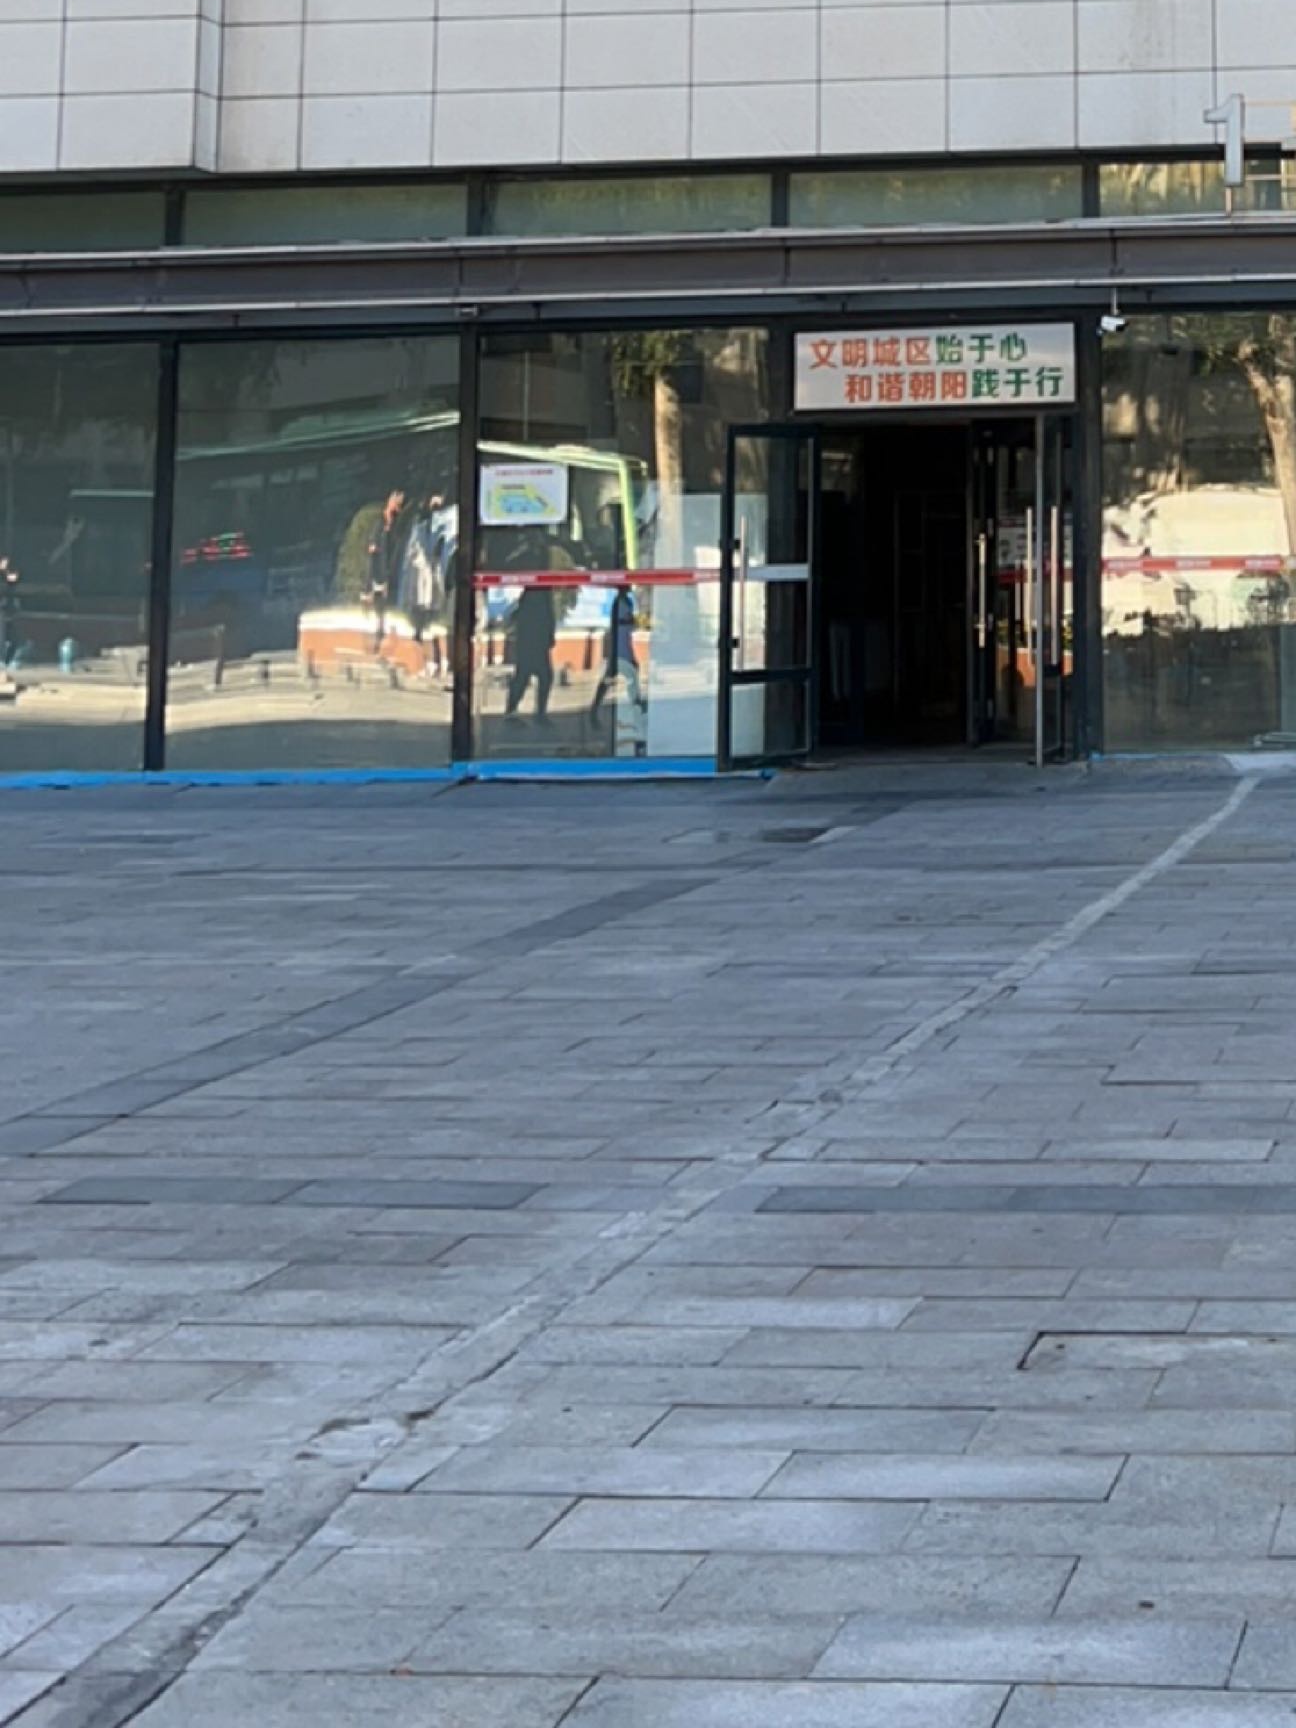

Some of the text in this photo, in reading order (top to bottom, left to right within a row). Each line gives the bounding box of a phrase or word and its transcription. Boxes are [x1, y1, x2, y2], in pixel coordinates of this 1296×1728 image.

[809, 332, 1028, 370] 文明城区始于心
[844, 366, 1065, 403] 和谐朝阳践于行
